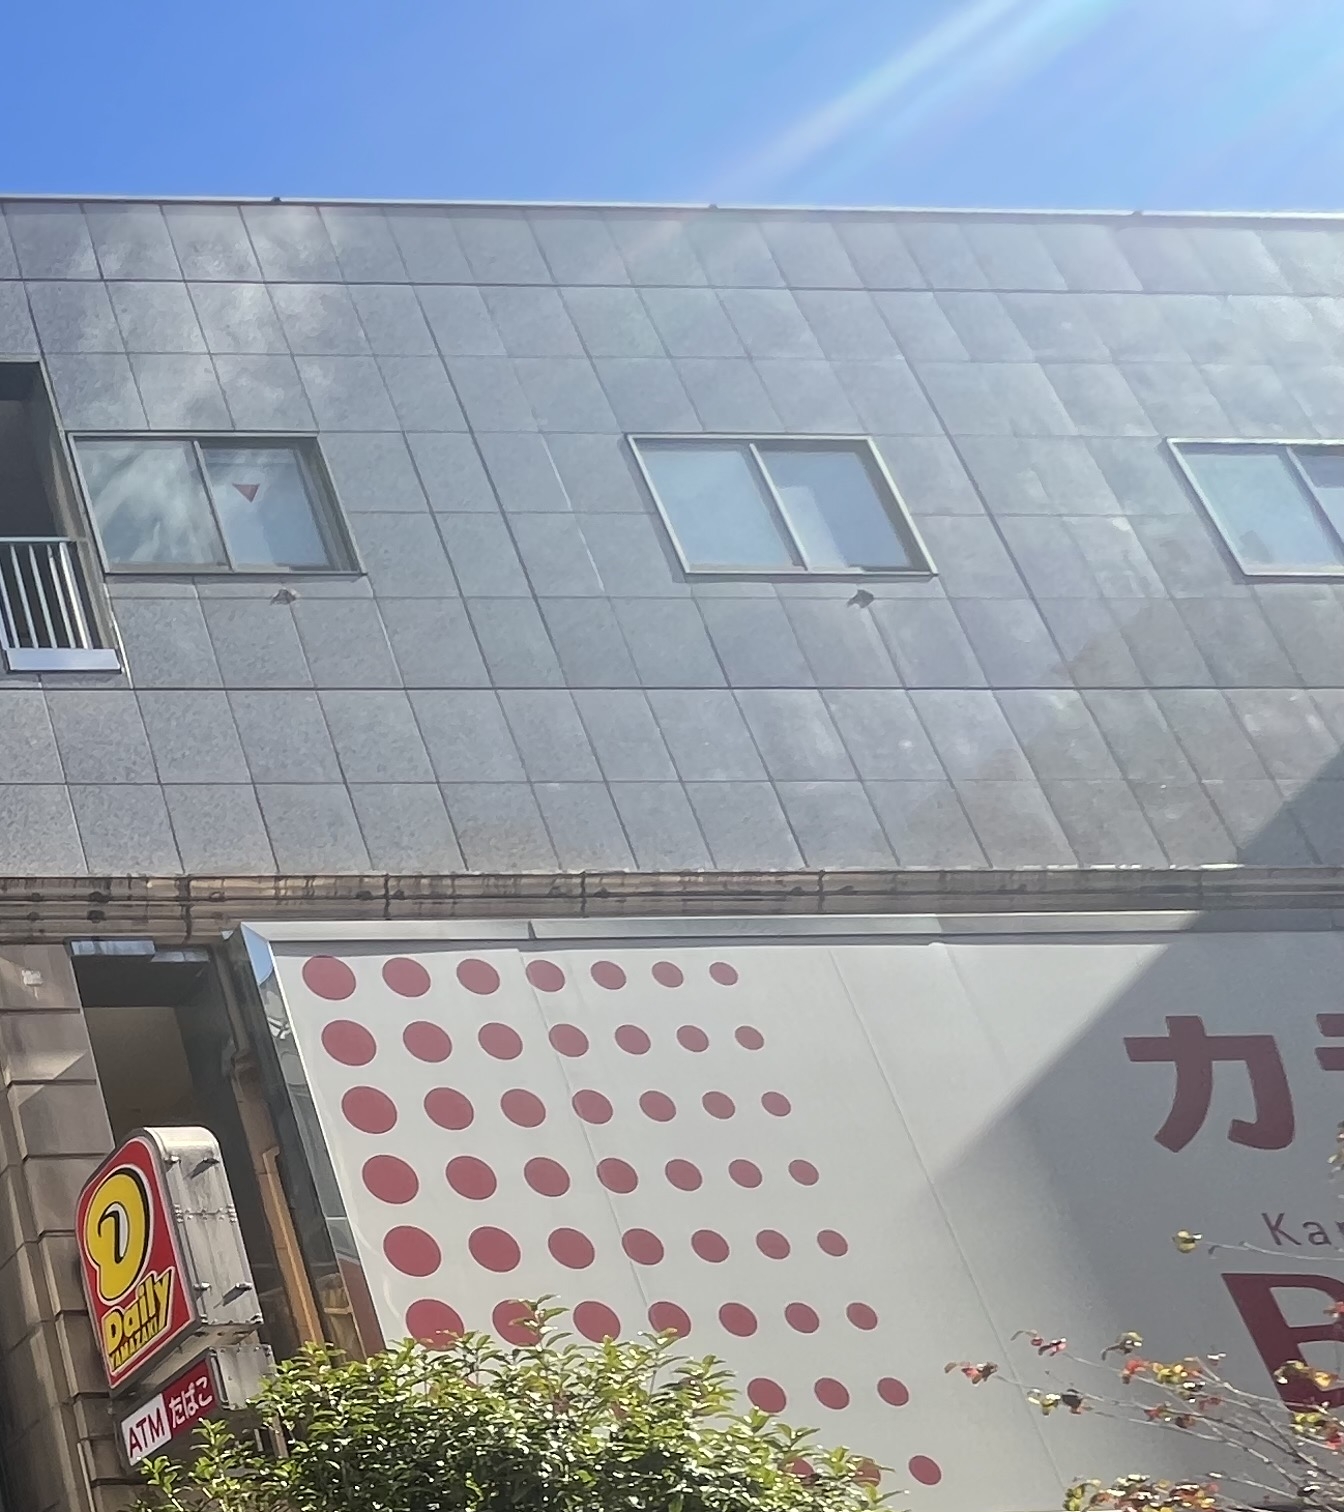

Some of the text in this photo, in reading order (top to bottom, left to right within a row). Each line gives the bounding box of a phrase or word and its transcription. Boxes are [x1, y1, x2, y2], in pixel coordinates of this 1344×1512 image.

[1261, 1212, 1344, 1246] Ka
[102, 1266, 175, 1349] Daily
[108, 1318, 161, 1369] YAMAZAKI
[168, 1375, 214, 1429] たばこ
[126, 1411, 166, 1459] ATM
